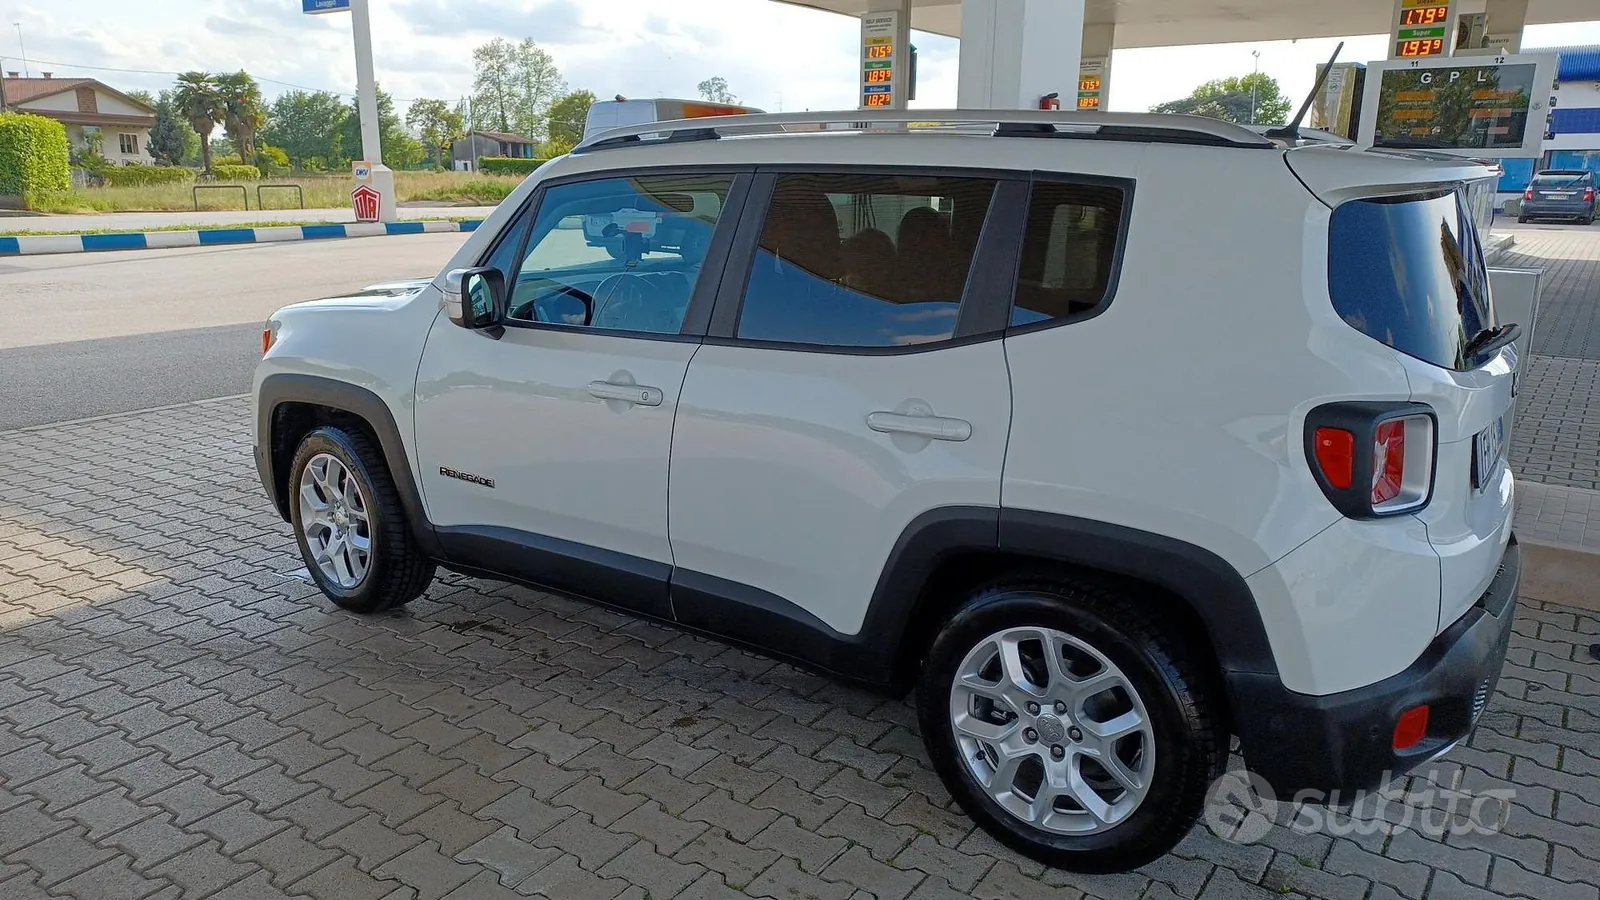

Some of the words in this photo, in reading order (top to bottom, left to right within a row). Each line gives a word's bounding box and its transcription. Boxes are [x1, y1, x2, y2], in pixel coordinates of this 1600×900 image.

[1412, 29, 1431, 37] Super
[355, 168, 369, 176] DKV
[440, 466, 495, 488] RENEGADE
